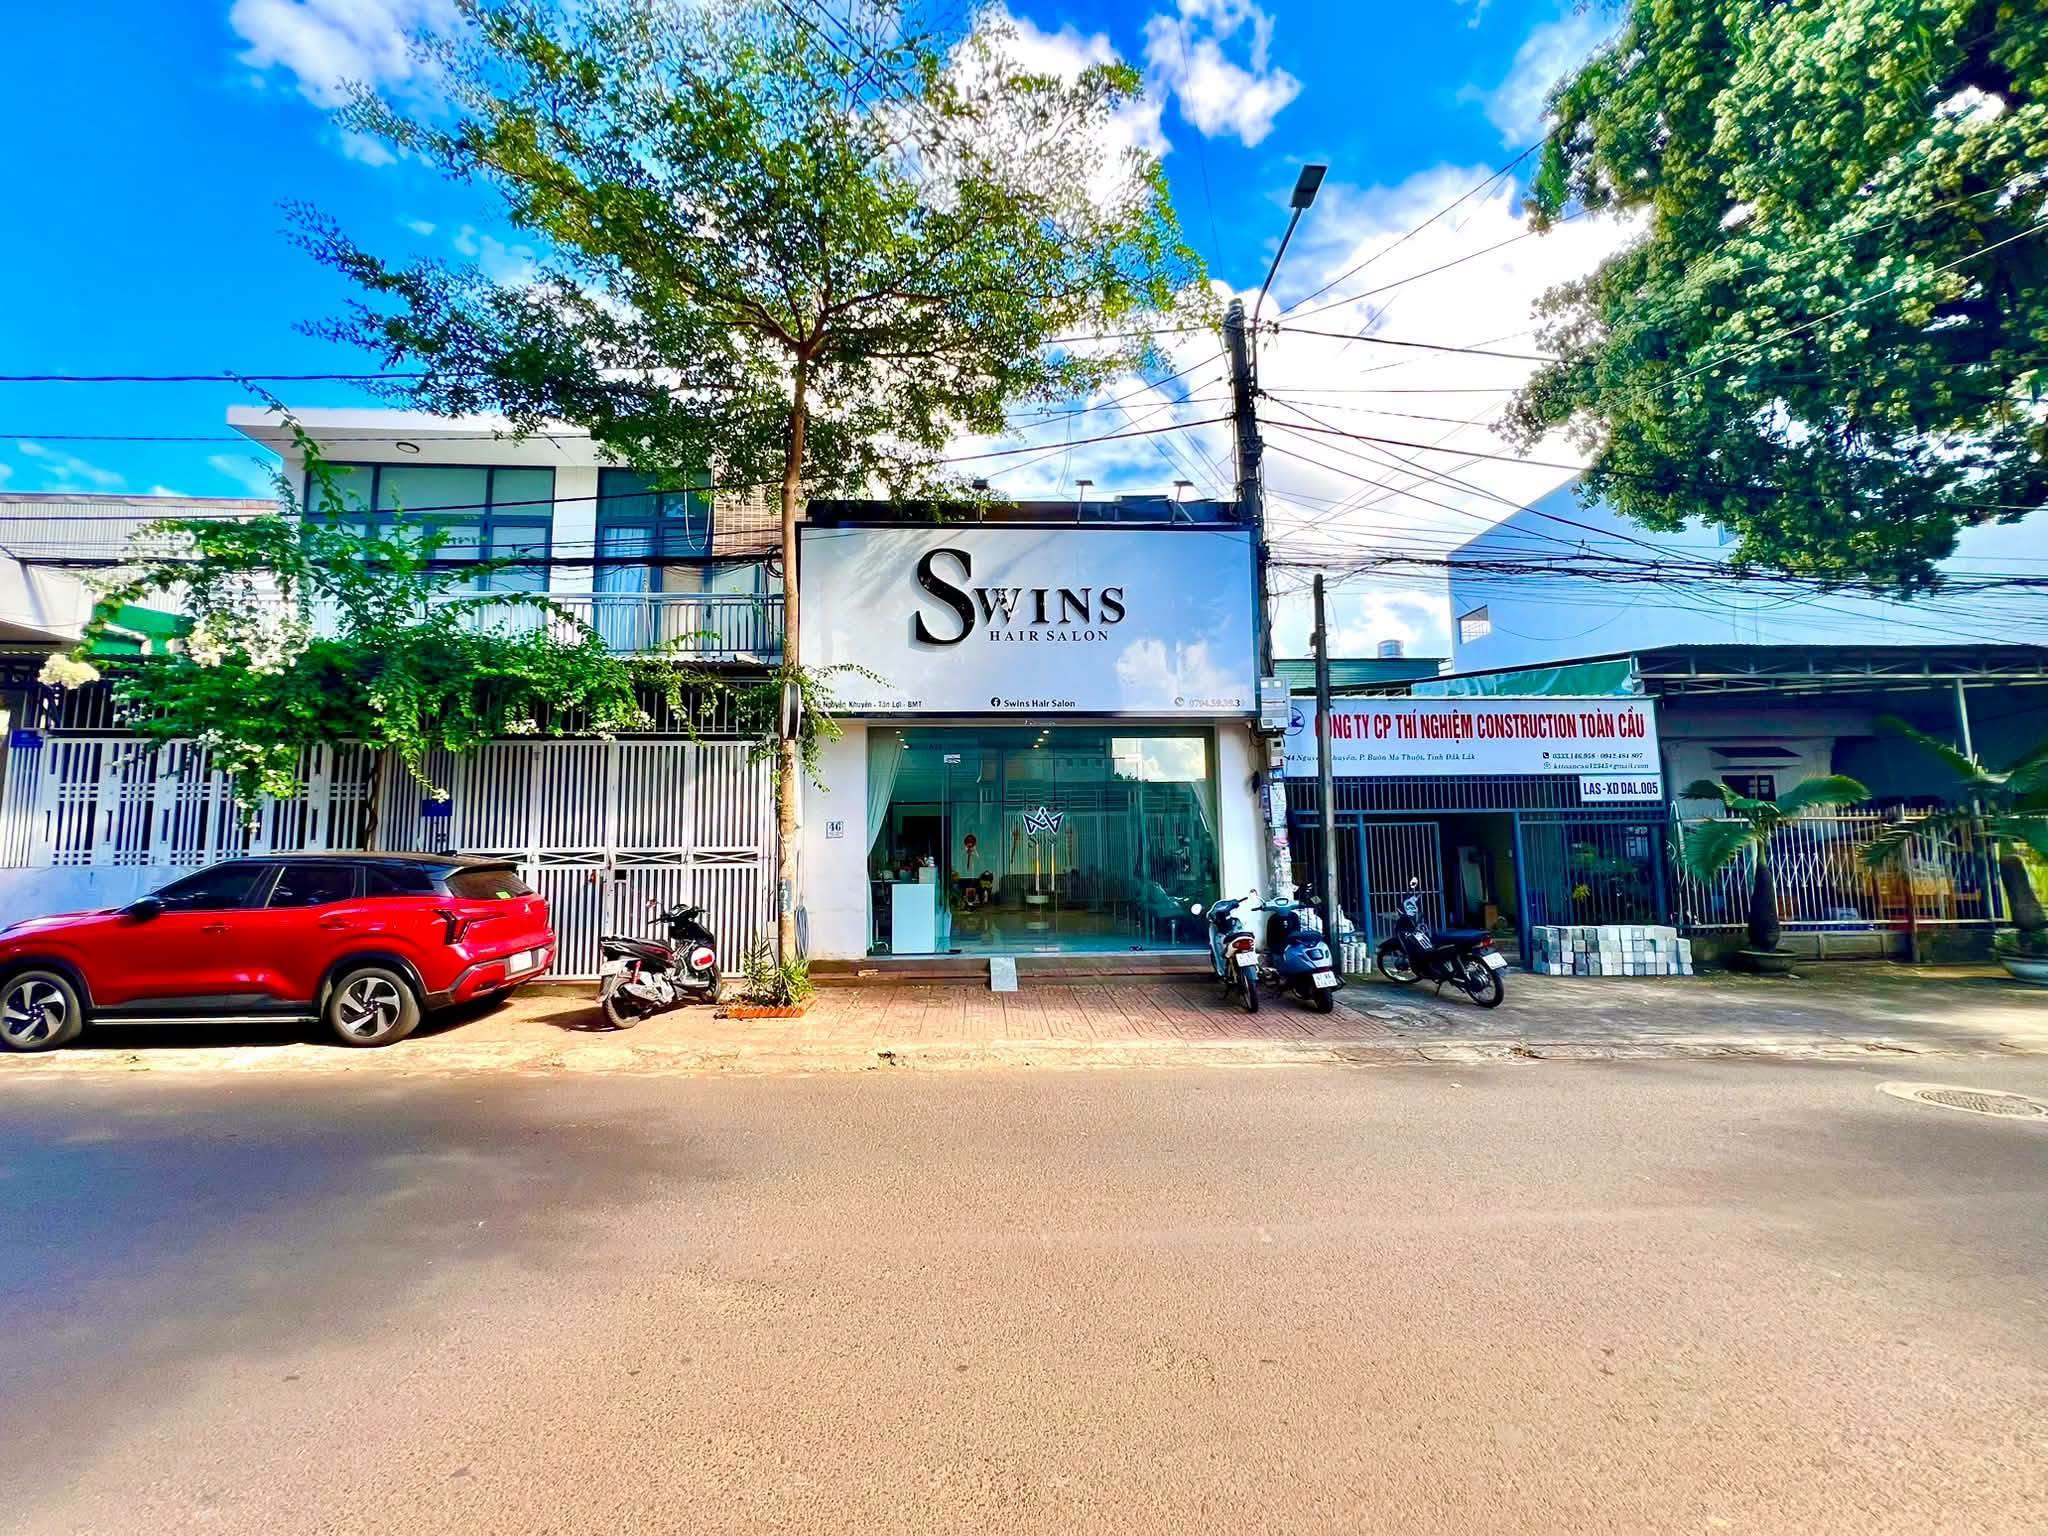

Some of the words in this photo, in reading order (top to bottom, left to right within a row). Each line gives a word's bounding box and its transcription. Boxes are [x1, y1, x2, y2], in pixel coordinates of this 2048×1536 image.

[990, 630, 1039, 641] HAIR
[1047, 630, 1108, 641] SALON
[1004, 700, 1030, 708] Swins
[1032, 700, 1050, 708] Hair
[1052, 700, 1076, 708] Salon
[1354, 714, 1369, 739] TY
[1374, 714, 1392, 739] CP
[1395, 708, 1417, 739] THÍ
[1420, 709, 1473, 744] NGHIỆM
[1477, 713, 1577, 739] CONSTRUCTION
[1580, 707, 1615, 738] TOÀN
[1618, 706, 1645, 738] CẦU
[1621, 782, 1658, 795] DAL.005
